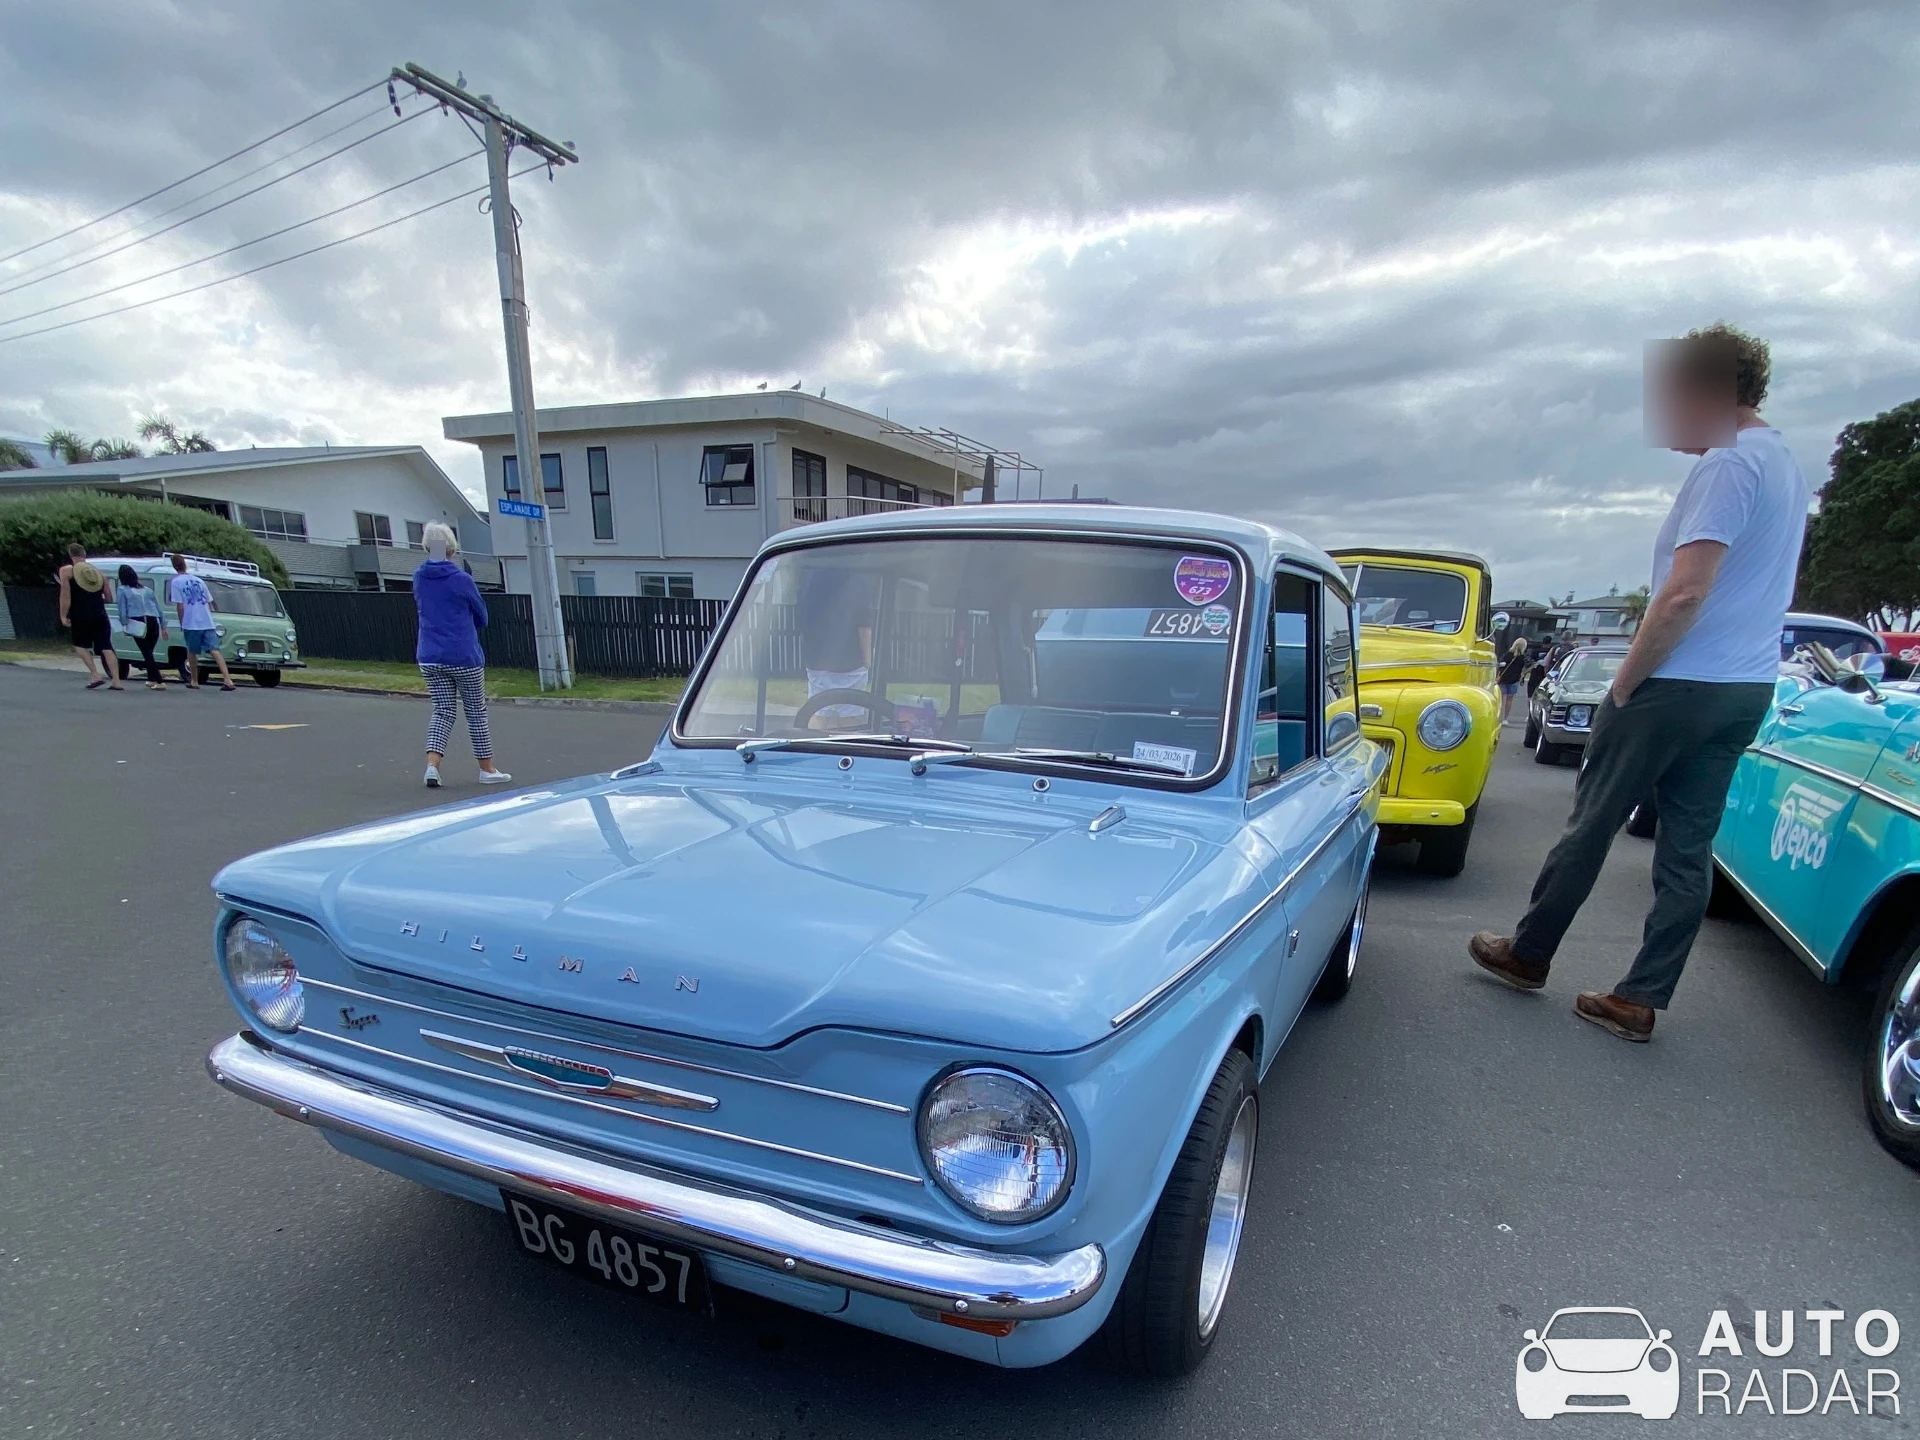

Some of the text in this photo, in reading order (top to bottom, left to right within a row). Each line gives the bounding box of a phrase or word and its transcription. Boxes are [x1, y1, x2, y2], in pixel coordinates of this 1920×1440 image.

[500, 501, 540, 516] ESPLANADE DR
[1188, 586, 1212, 595] 673
[1136, 747, 1182, 761] 24/03/2026
[1771, 797, 1827, 870] Repco
[400, 919, 700, 993] HILLMAN
[511, 1199, 691, 1303] BG 4857
